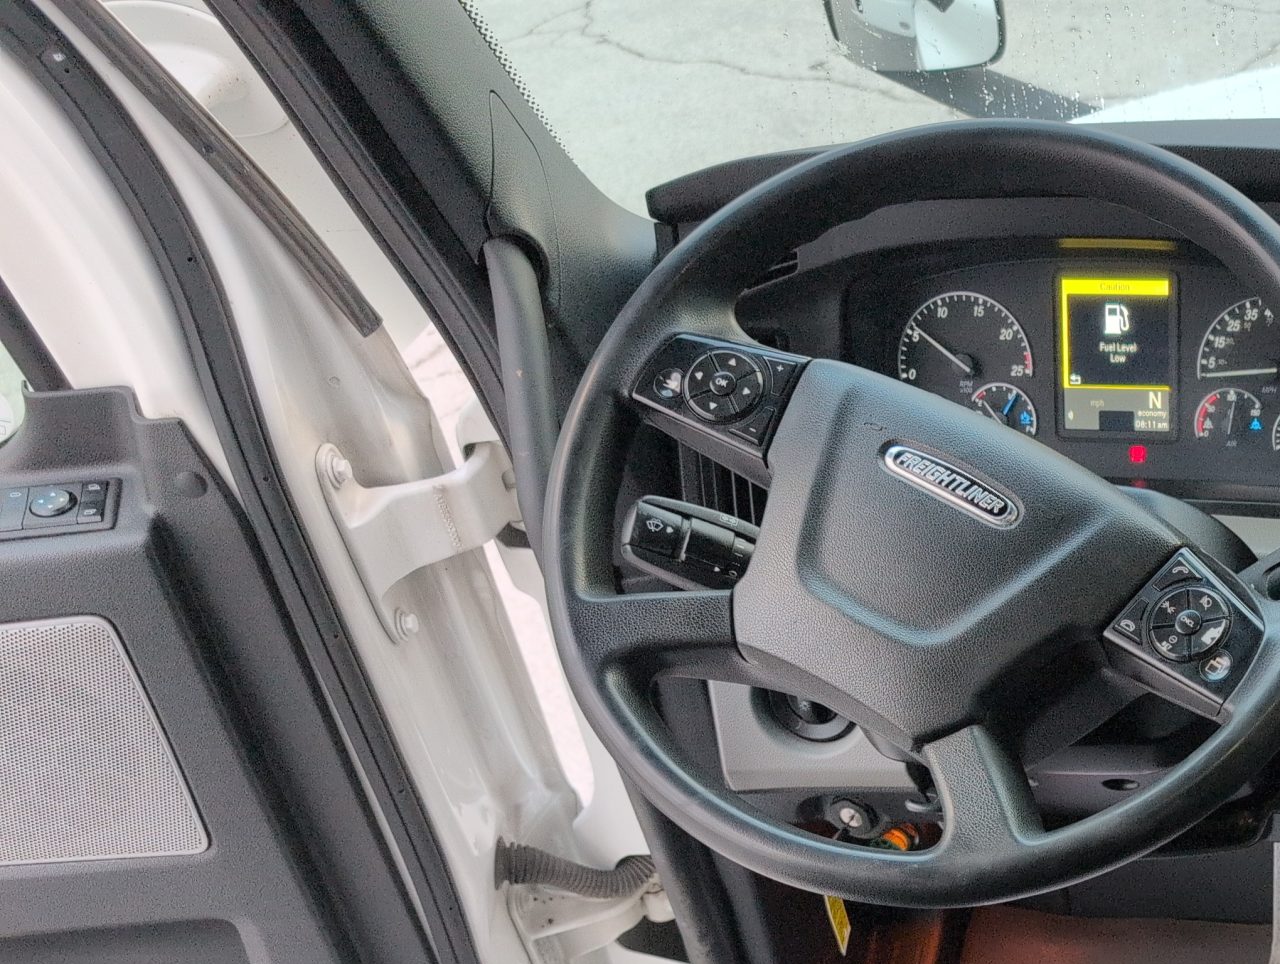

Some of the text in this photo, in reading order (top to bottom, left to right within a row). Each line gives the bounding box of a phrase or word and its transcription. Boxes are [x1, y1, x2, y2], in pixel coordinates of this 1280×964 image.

[1100, 282, 1130, 292] Caution
[937, 307, 948, 318] 10
[973, 306, 984, 317] 15
[1244, 308, 1258, 321] 35
[1226, 320, 1240, 332] 25
[912, 332, 920, 342] 5
[999, 328, 1014, 340] 20
[1099, 342, 1137, 353] Fuel Level
[1215, 336, 1226, 348] 15
[1110, 354, 1127, 364] Low
[1208, 357, 1216, 369] 5
[908, 369, 916, 380] 0
[1011, 365, 1024, 377] 25
[715, 377, 729, 389] OK
[1090, 400, 1105, 408] mph
[1149, 391, 1162, 409] N
[1138, 411, 1167, 419] economy
[1250, 409, 1260, 417] 150
[896, 451, 1005, 514] FREIGHTLINER
